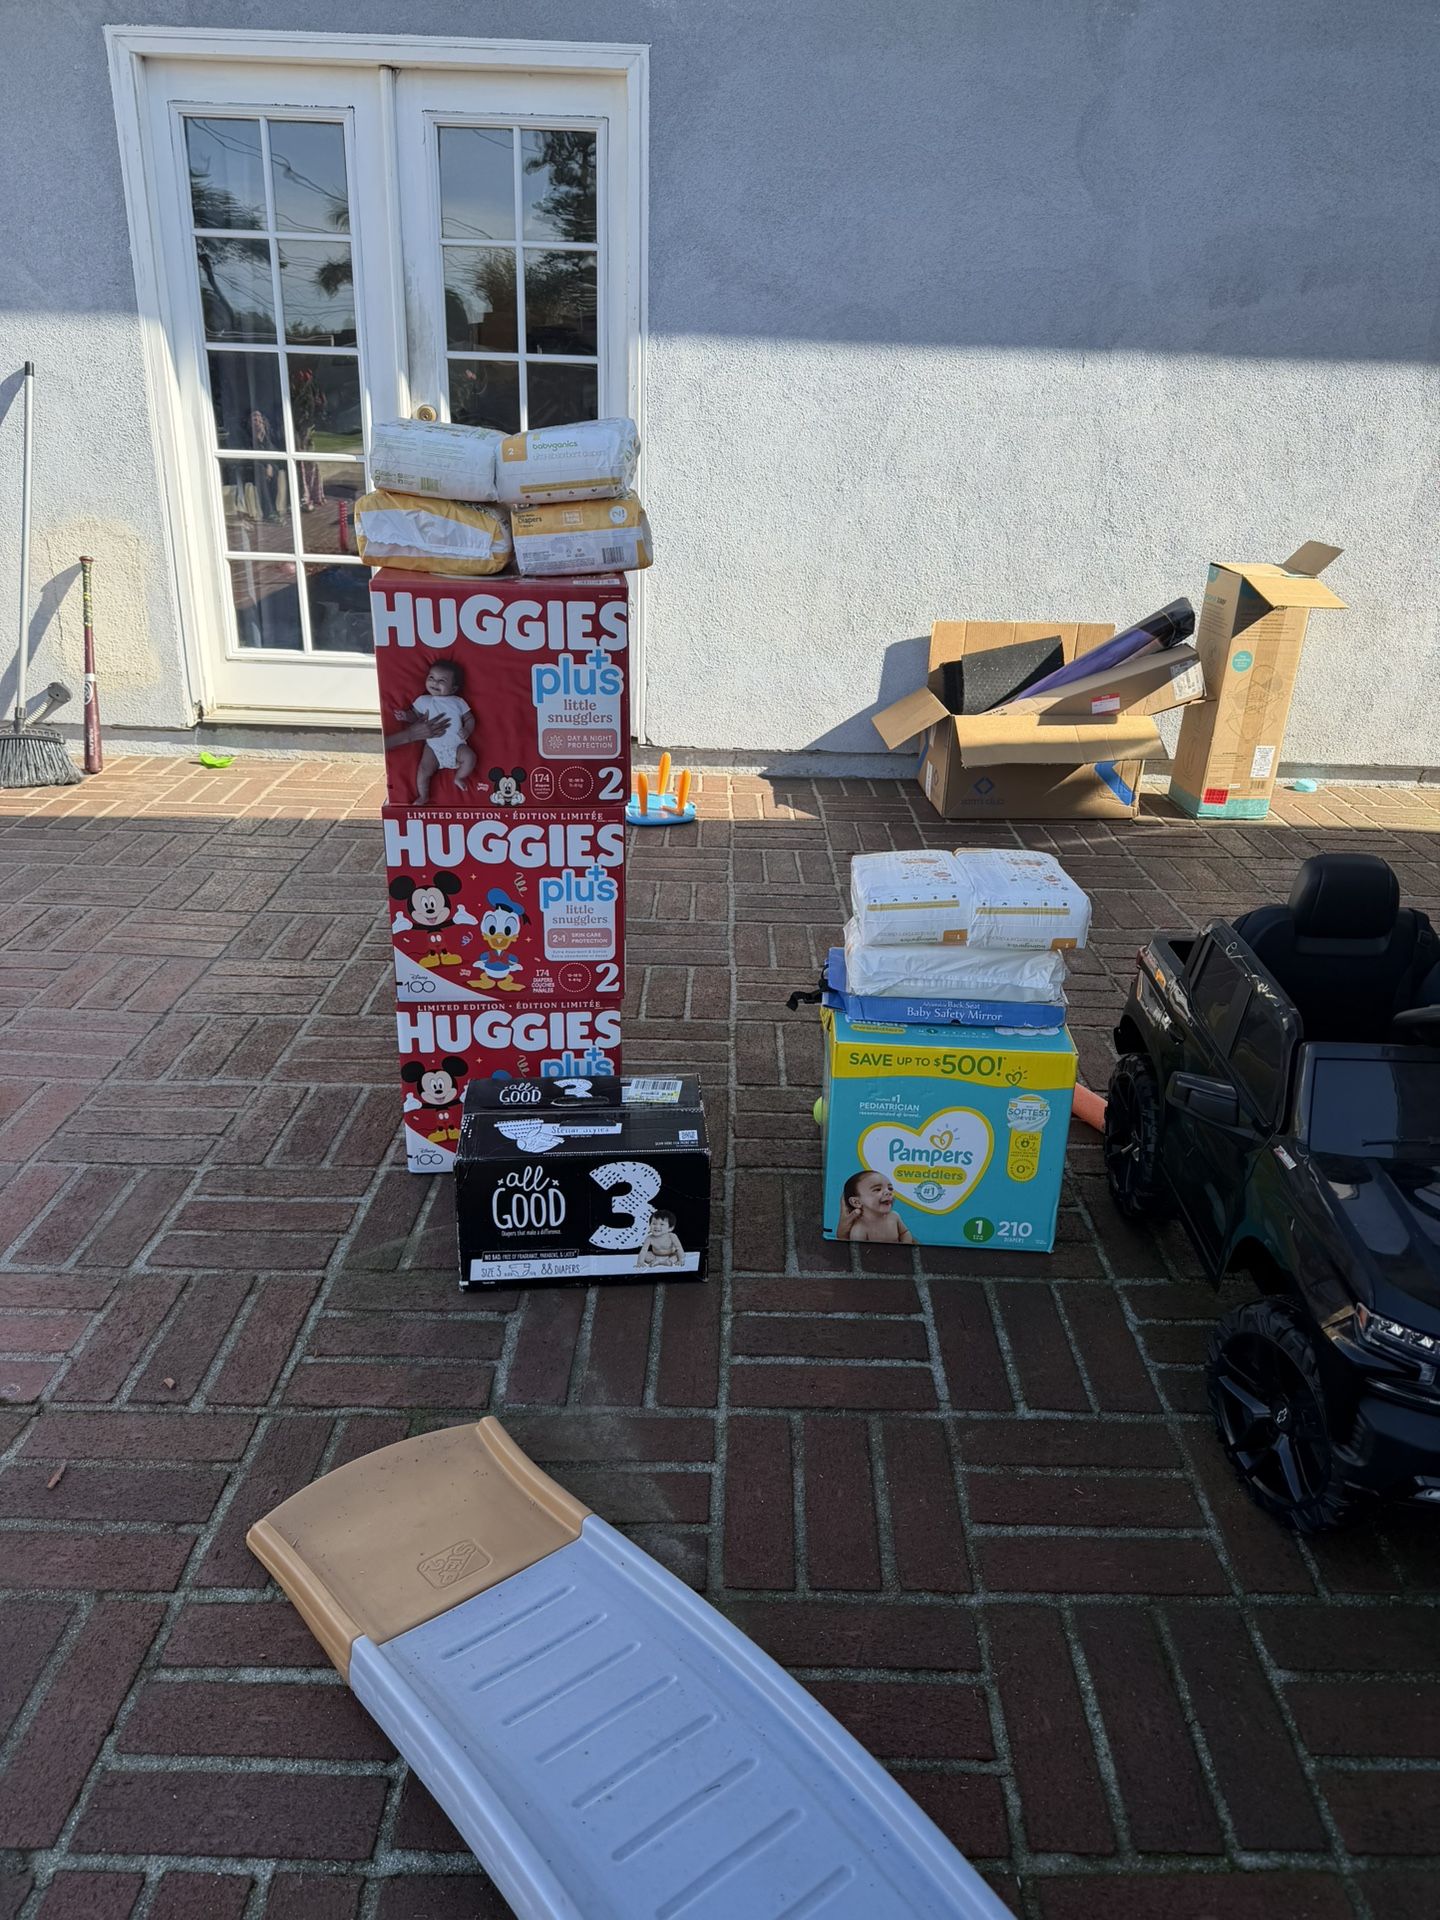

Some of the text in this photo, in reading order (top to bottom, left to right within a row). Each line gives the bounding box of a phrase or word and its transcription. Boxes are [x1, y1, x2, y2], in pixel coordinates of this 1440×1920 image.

[507, 447, 515, 456] 2
[532, 440, 578, 452] babyganics
[517, 516, 543, 525] Diapers
[370, 591, 628, 651] HUGGIES
[535, 656, 620, 704] plus
[563, 698, 597, 711] little
[547, 711, 613, 726] snugglers
[534, 773, 550, 783] 174
[598, 766, 624, 800] 2
[407, 811, 452, 821] LIMITED
[456, 811, 501, 821] EDITION
[512, 810, 557, 820] ÉDITION
[560, 811, 604, 821] LIMITÉE
[383, 819, 624, 868] HUGGIES
[542, 871, 615, 909] plus
[566, 904, 594, 914] little
[552, 914, 608, 926] snugglers
[410, 973, 428, 981] Disney
[535, 969, 550, 977] 174
[595, 962, 620, 993] 2
[404, 980, 436, 994] 100
[417, 1003, 460, 1012] LIMITED
[463, 1002, 505, 1011] EDITION
[516, 1001, 557, 1010] ÉDITION
[560, 999, 601, 1009] LIMITÉE
[947, 1001, 963, 1009] Back
[965, 1001, 981, 1010] Seat
[907, 1006, 1003, 1021] Baby Safety Mirror
[396, 1009, 621, 1054] HUGGIES
[542, 1053, 612, 1077] plus
[849, 1052, 893, 1067] SAVE
[896, 1056, 912, 1066] UP
[915, 1057, 931, 1067] TO
[508, 1082, 535, 1091] all
[499, 1088, 542, 1104] GOOD
[859, 1101, 920, 1112] PEDIATRICIAN
[1007, 1107, 1050, 1117] SOFTEST
[888, 1137, 974, 1167] Pampers
[413, 1153, 444, 1166] 100
[505, 1164, 550, 1192] all
[896, 1169, 964, 1181] swaddlers
[922, 1187, 935, 1195] #1
[491, 1187, 566, 1230] GOOD
[588, 1161, 662, 1250] 3
[501, 1230, 517, 1238] Diapers
[975, 1220, 984, 1235] 1
[997, 1221, 1033, 1238] 210
[481, 1267, 495, 1278] SIZE
[496, 1264, 502, 1278] 3
[541, 1263, 552, 1275] 88
[554, 1264, 581, 1275] DIAPERS
